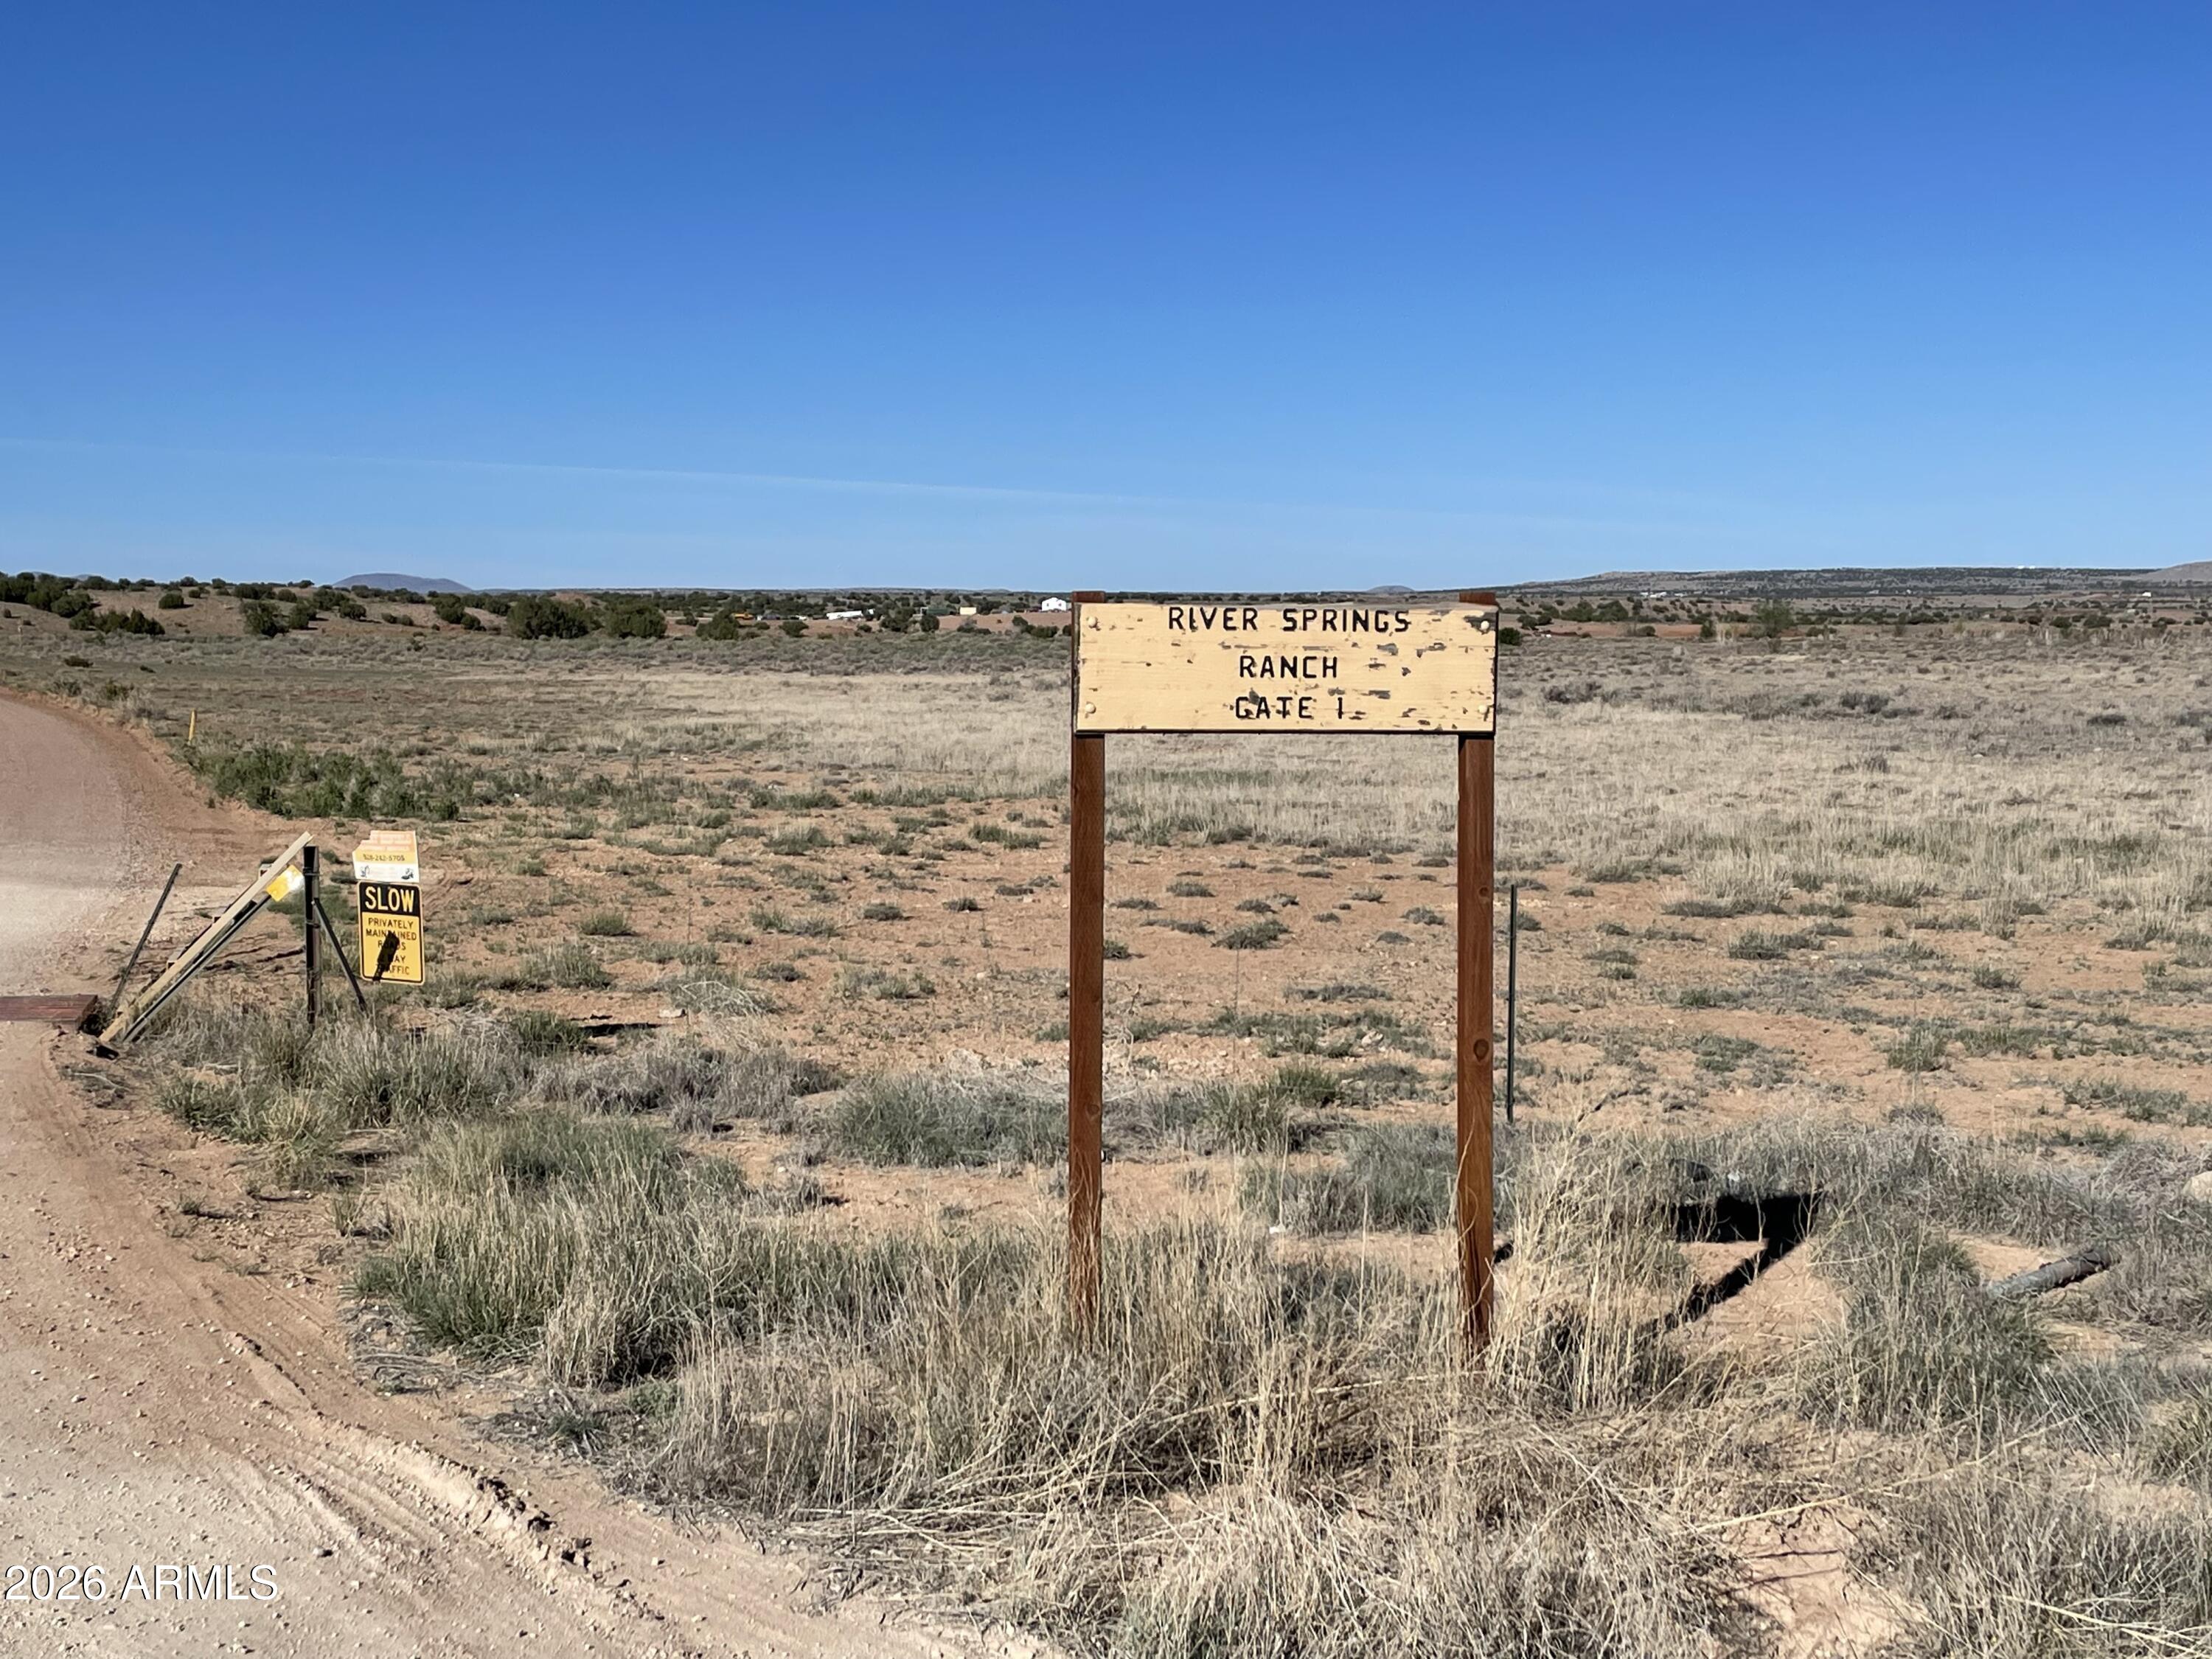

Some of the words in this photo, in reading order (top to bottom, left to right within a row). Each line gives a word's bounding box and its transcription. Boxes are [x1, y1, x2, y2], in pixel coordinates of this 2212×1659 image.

[1169, 607, 1258, 631] RIVER
[1283, 608, 1411, 633] SPRINGS
[1239, 655, 1338, 678] RANCH
[1235, 697, 1315, 720] GATE
[1337, 697, 1344, 720] 1
[365, 886, 414, 913] SLOW
[366, 928, 417, 940] MAININED
[368, 917, 414, 930] PRIVATELY
[377, 964, 410, 975] FFIC
